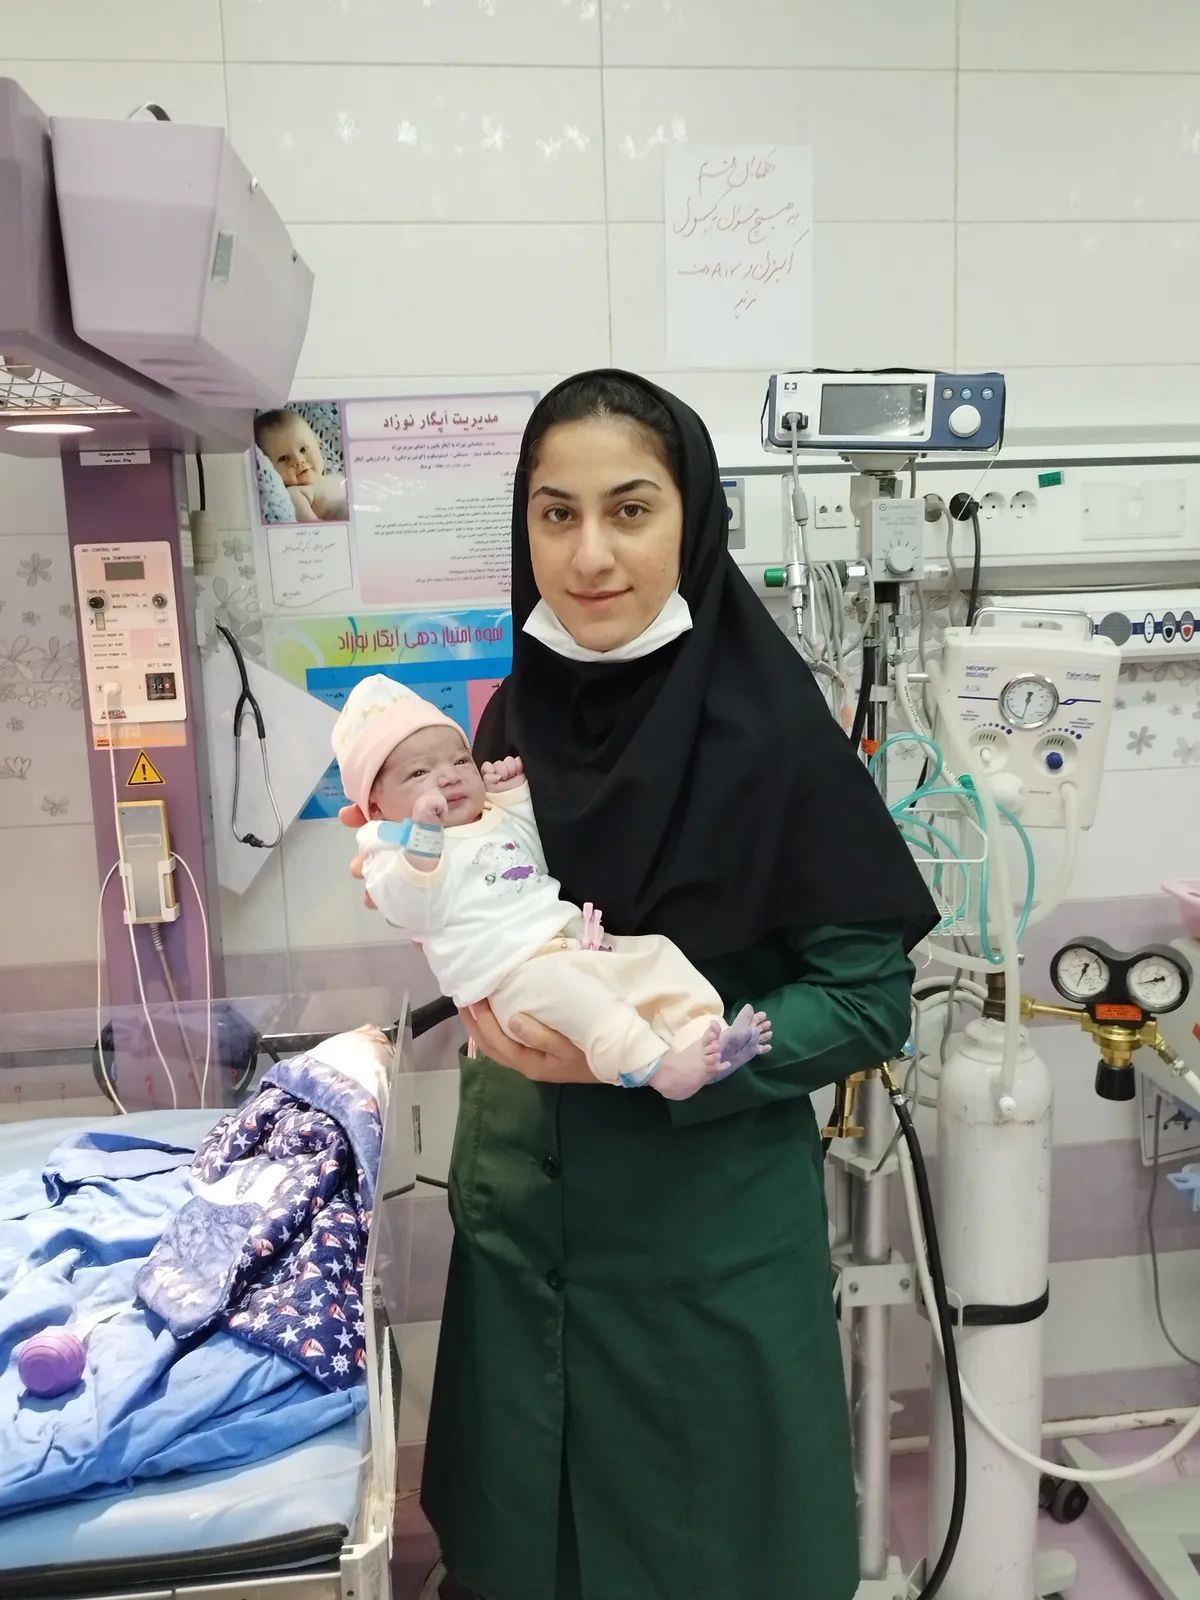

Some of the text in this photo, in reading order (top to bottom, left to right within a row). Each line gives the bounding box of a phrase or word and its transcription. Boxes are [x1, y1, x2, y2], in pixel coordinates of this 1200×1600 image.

[383, 410, 499, 433] مدیریت آپگار نوزاد
[337, 631, 368, 653] نوزاد
[373, 625, 399, 652] آپگار
[404, 629, 438, 649] دهی
[443, 624, 472, 648] امتیاز
